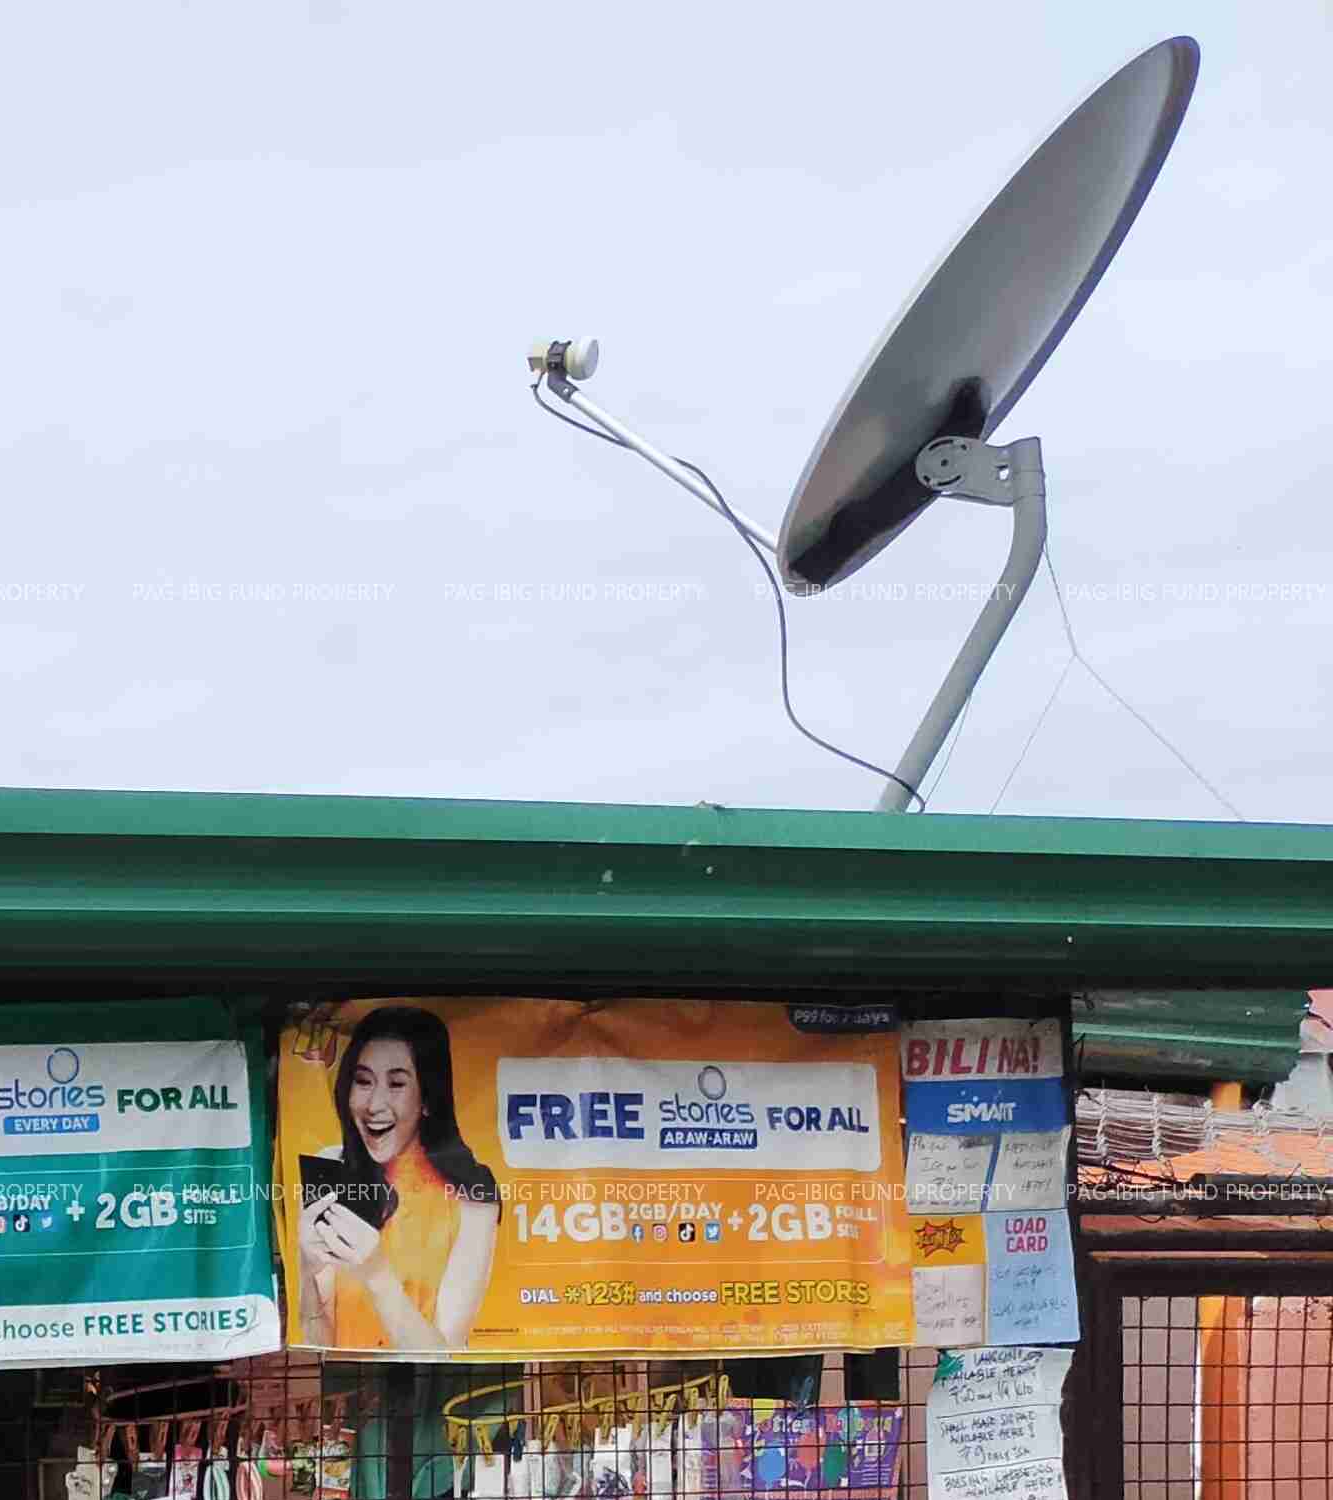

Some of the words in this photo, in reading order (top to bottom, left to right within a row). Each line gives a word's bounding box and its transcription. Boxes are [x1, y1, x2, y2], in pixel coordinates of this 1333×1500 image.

[906, 1038, 990, 1076] BILI
[997, 1036, 1041, 1074] NA!
[118, 1087, 183, 1114] FOR
[188, 1085, 238, 1111] ALL
[14, 1117, 58, 1133] EVERY
[62, 1115, 91, 1131] DAY
[506, 1092, 645, 1140] FREE
[659, 1093, 755, 1124] stories
[767, 1105, 823, 1132] FOR
[827, 1106, 869, 1133] ALL
[663, 1130, 754, 1146] ARAW-ARAW
[513, 1202, 628, 1242] 14GB
[628, 1202, 724, 1222] 2GB/DAY
[1005, 1217, 1047, 1234] LOAD
[1006, 1235, 1049, 1253] CARD
[519, 1287, 560, 1304] DIAL
[638, 1289, 663, 1303] and
[665, 1288, 718, 1303] choose
[720, 1281, 780, 1304] FREE
[84, 1312, 144, 1336] FREE
[153, 1308, 248, 1333] STORIES
